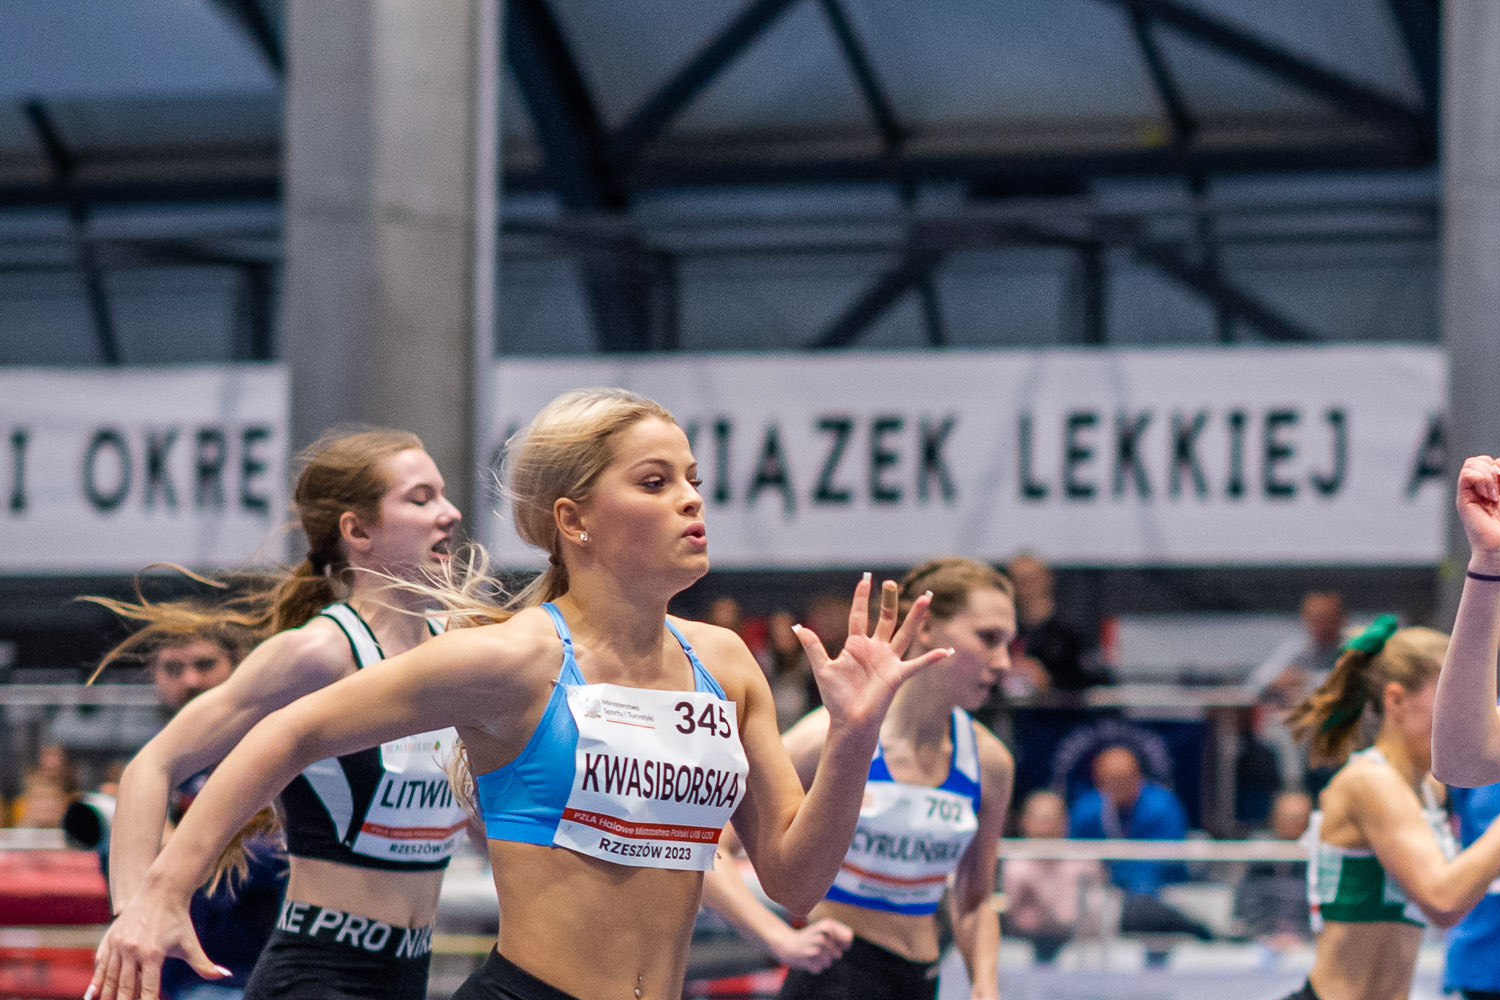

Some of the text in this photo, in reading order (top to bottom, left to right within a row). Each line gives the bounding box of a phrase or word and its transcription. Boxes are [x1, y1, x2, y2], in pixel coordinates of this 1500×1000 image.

[1018, 408, 1348, 499] LEKKIEJ
[674, 701, 732, 739] 345
[582, 753, 739, 808] KWASIBORSKA
[574, 812, 597, 824] PZLA
[599, 818, 634, 834] Halowe
[599, 838, 692, 860] RZESZÓW 2023
[308, 906, 392, 952] PRO
